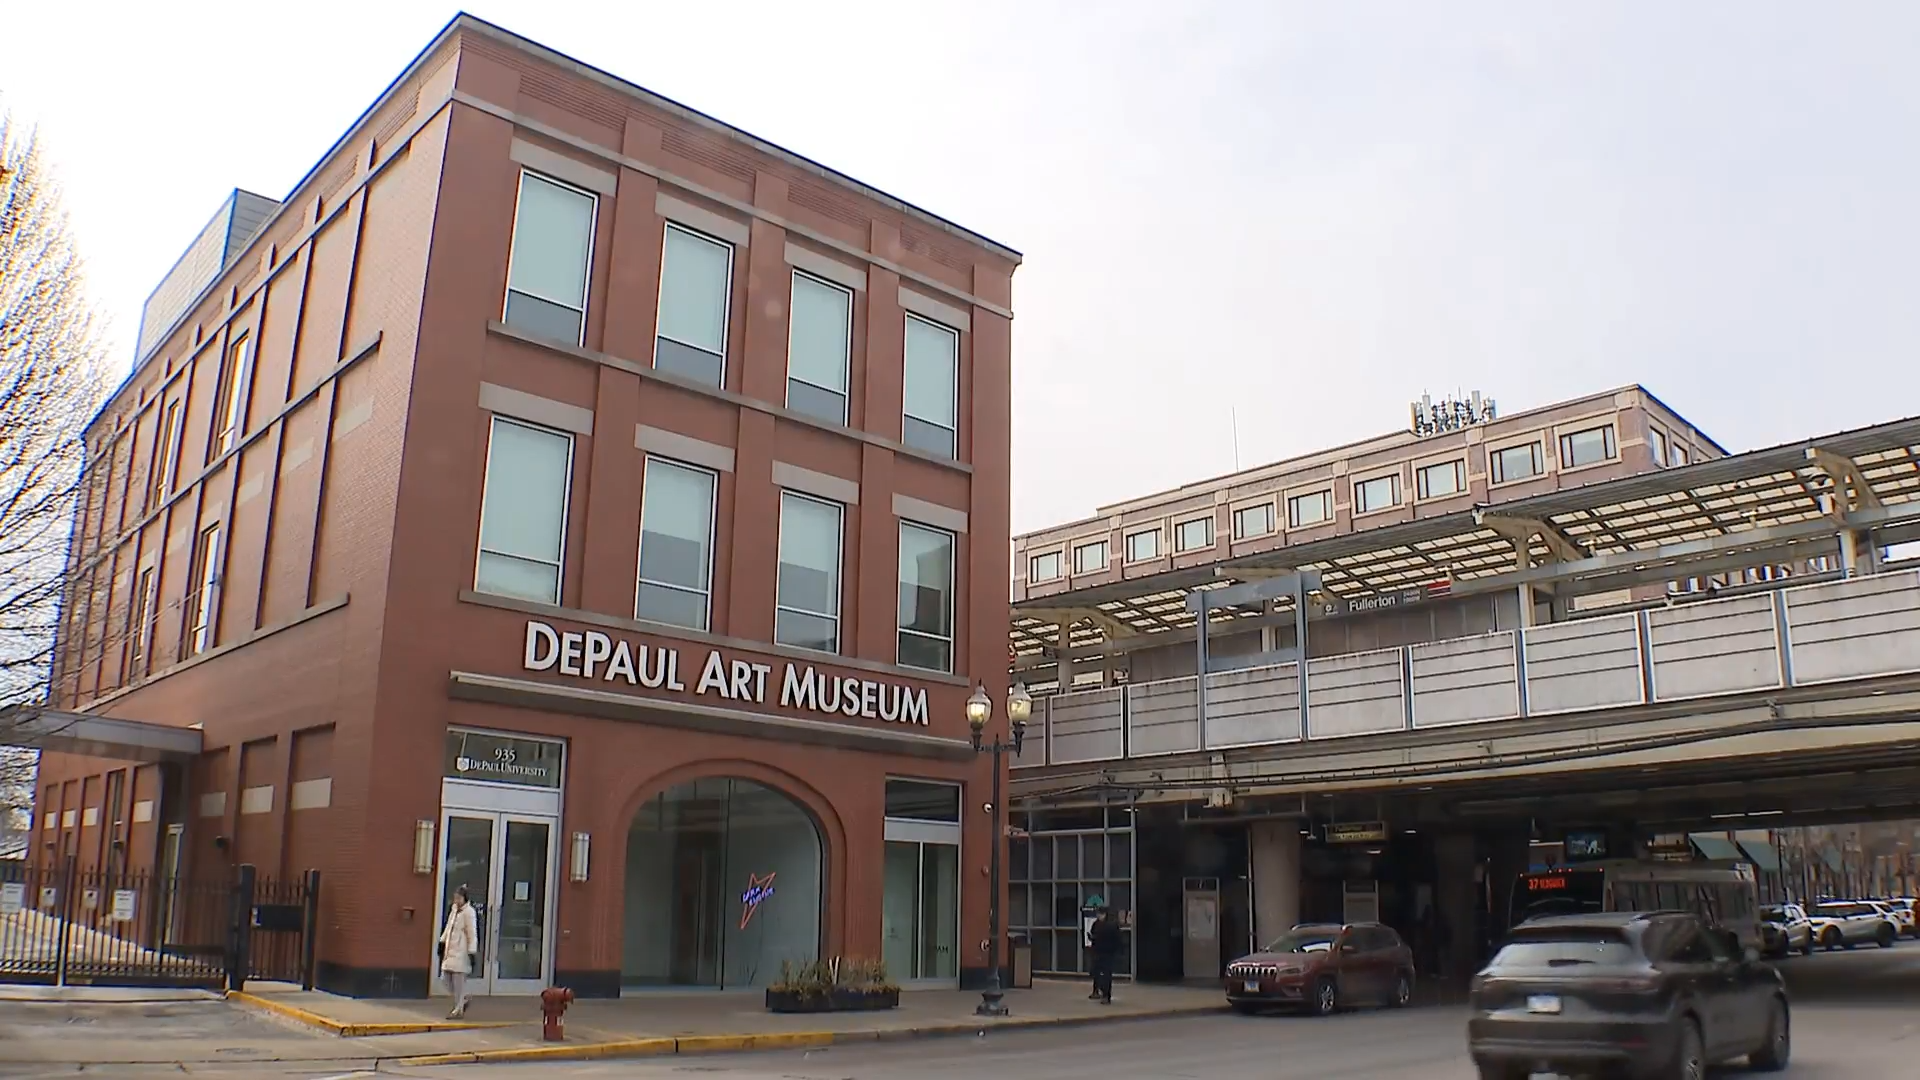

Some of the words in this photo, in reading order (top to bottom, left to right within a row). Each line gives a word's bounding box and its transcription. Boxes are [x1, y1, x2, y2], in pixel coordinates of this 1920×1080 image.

[1349, 595, 1396, 612] Fullerton
[524, 620, 685, 692] DEPAUL
[696, 650, 772, 703] ART
[780, 663, 929, 726] MUSEUM
[494, 748, 517, 762] 935
[501, 762, 548, 777] UNIVERSITY
[1528, 879, 1539, 890] 37
